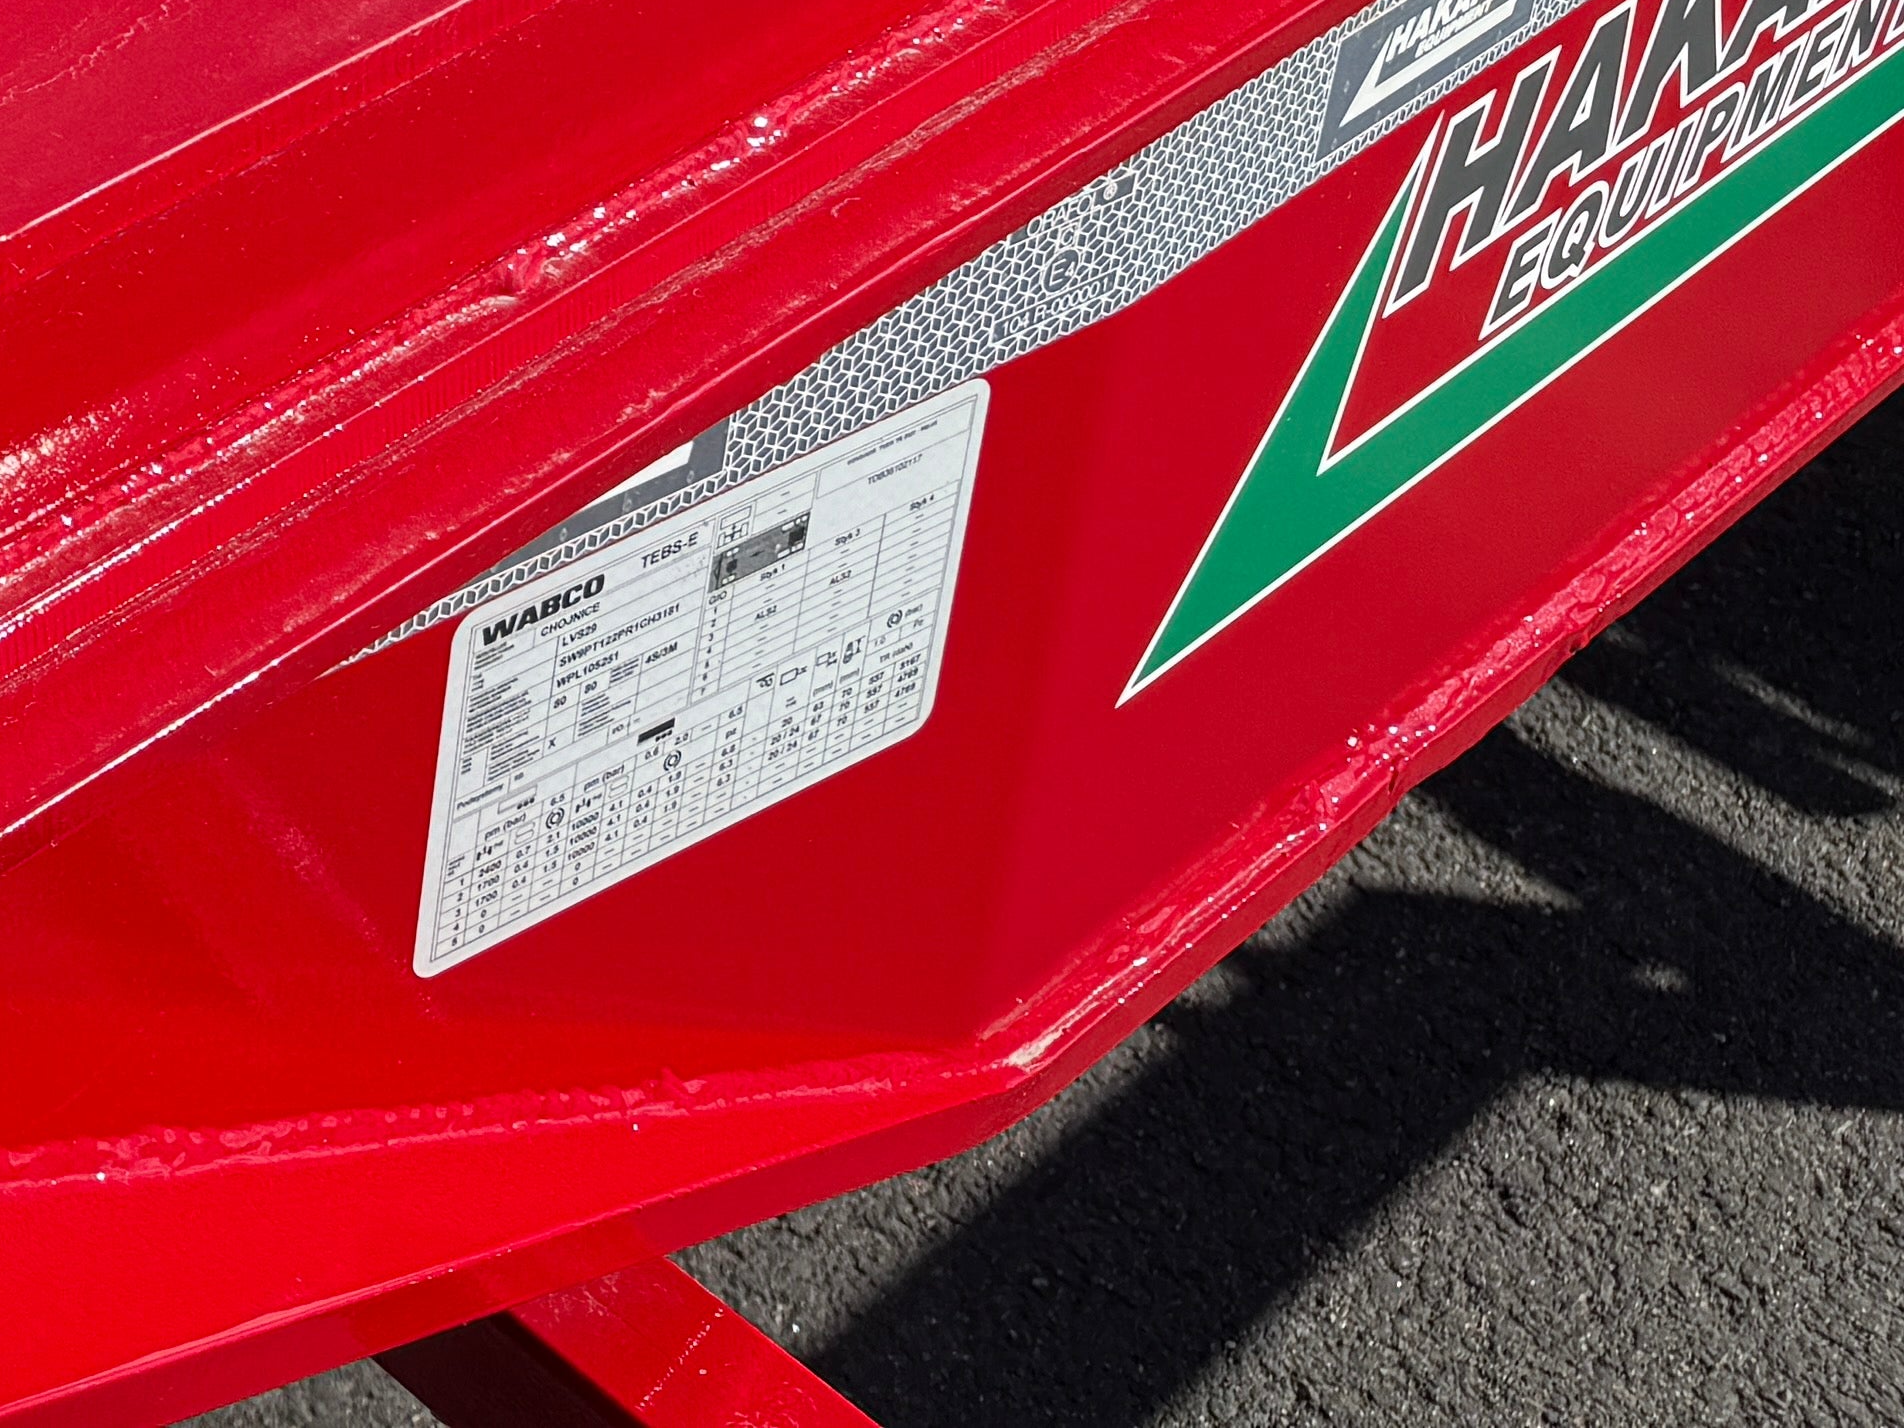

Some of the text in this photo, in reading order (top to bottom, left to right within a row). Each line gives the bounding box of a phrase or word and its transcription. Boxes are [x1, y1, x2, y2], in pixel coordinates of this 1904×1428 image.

[482, 531, 698, 646] WABCO TEBS-E
[541, 602, 600, 636] CHOJNICE
[562, 623, 597, 647] LVS29
[475, 890, 497, 907] 1700
[567, 841, 595, 860] 10000
[605, 830, 618, 841] 4.1
[477, 874, 500, 891] 1700
[570, 826, 597, 845] 10000
[607, 814, 621, 826] 4.1
[478, 860, 501, 877] 2400
[571, 811, 599, 831] 10000
[609, 800, 623, 811] 4.1
